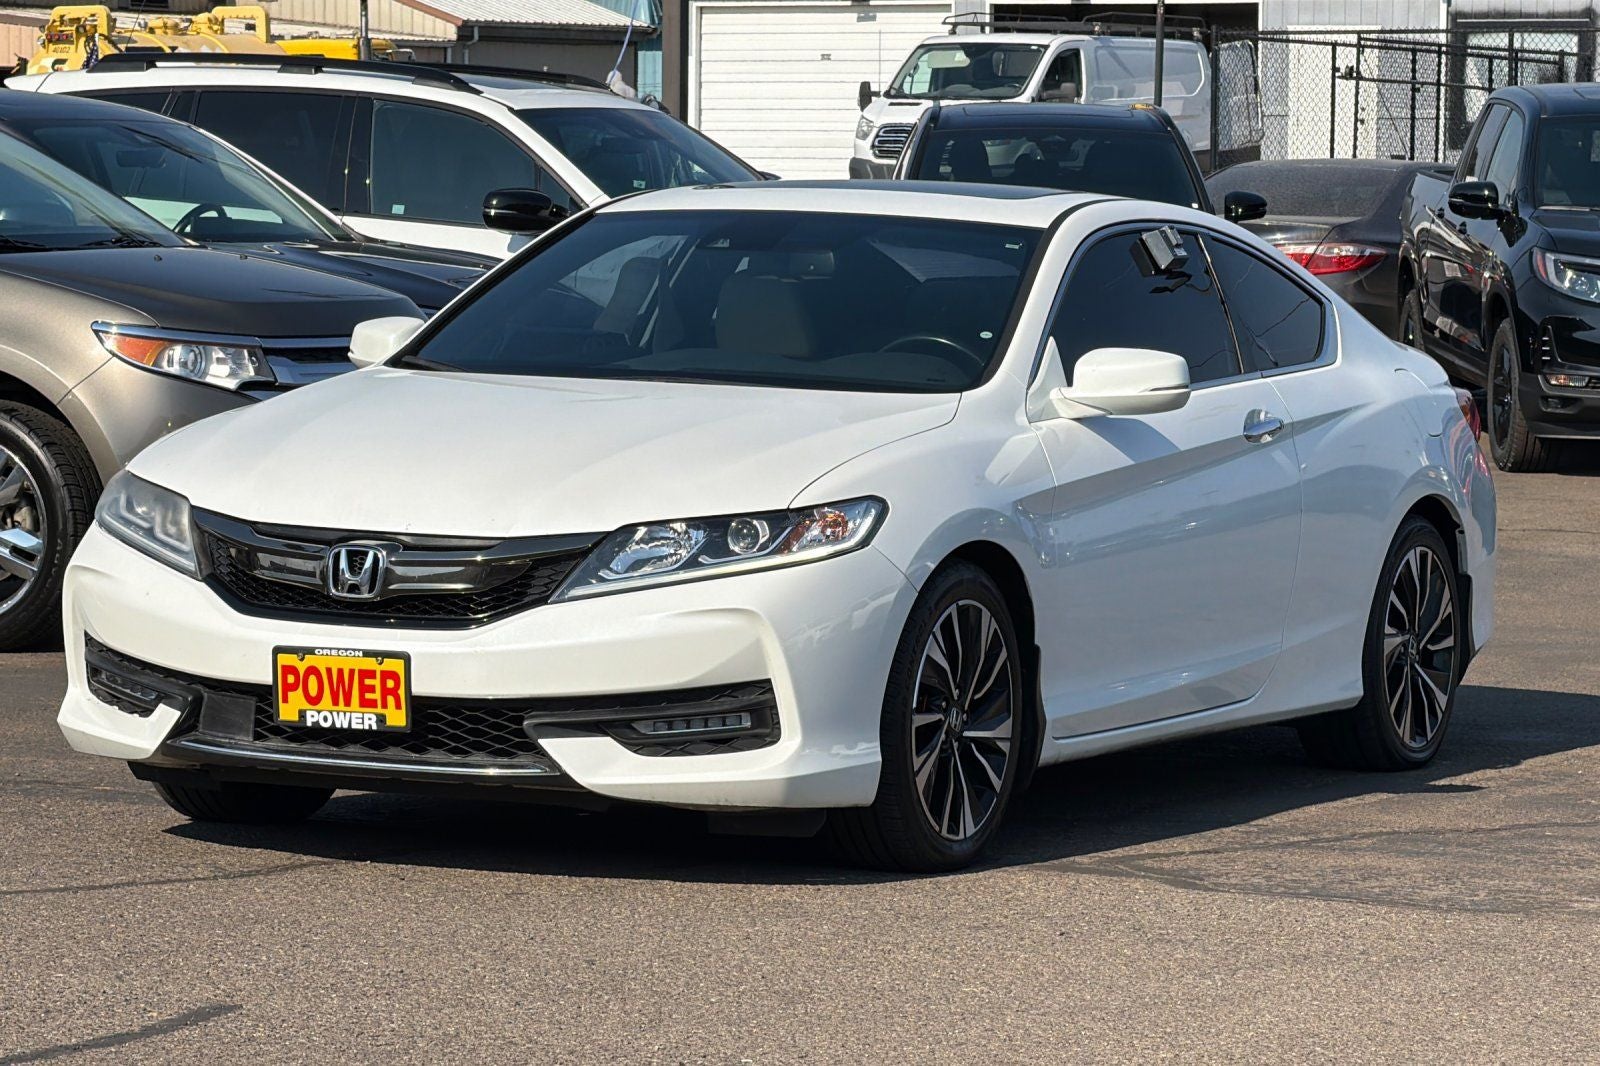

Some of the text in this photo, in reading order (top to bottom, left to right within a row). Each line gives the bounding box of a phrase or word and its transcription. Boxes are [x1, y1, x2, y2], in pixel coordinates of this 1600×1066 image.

[314, 648, 364, 658] OREGON
[280, 664, 403, 711] POWER
[305, 710, 378, 730] POWER
